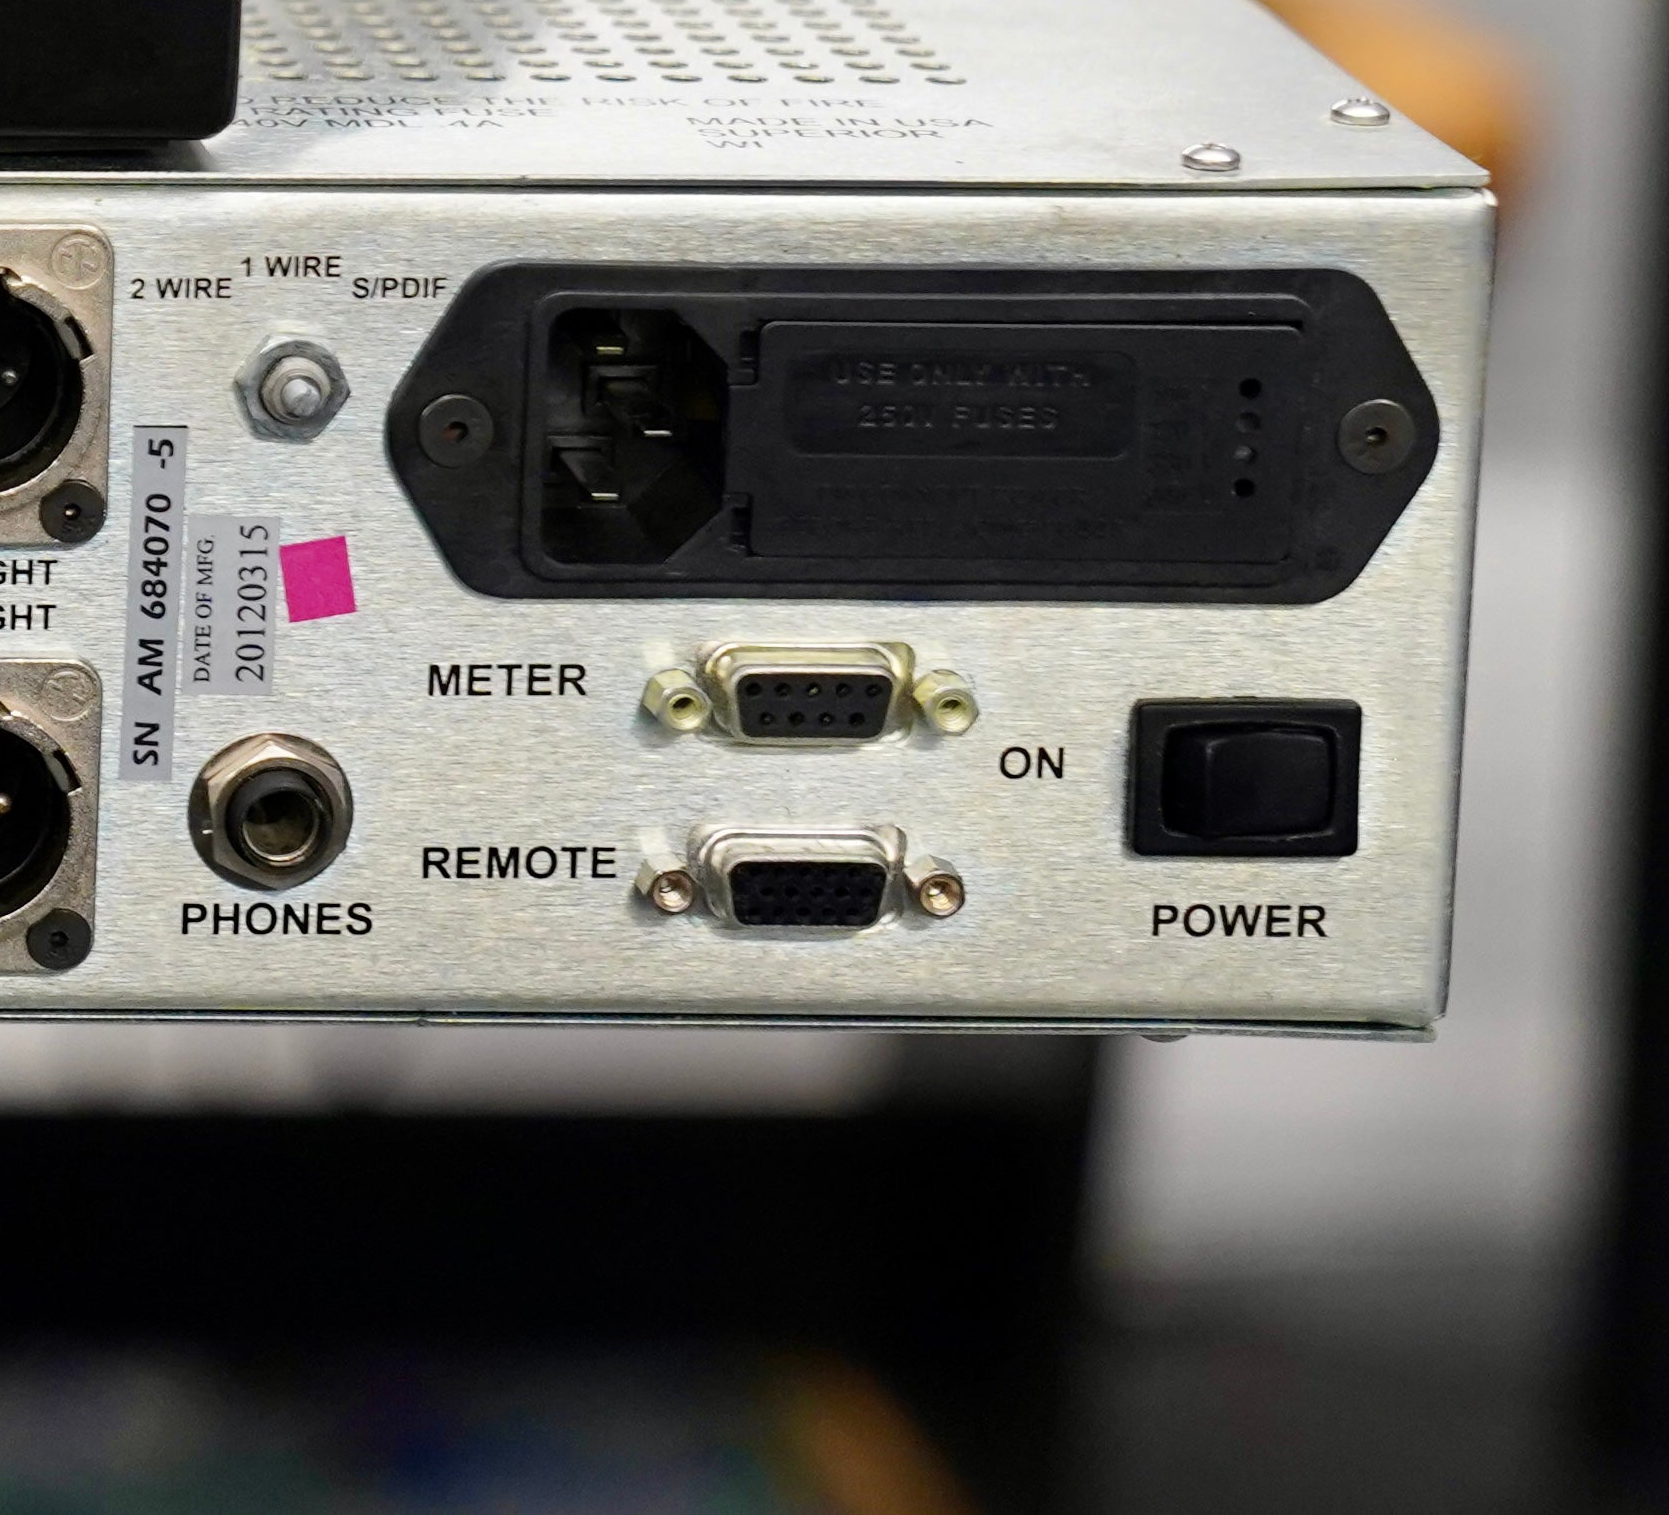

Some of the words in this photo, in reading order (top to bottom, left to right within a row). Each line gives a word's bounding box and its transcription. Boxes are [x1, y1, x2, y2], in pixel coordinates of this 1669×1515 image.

[249, 107, 420, 117] RATING
[434, 108, 556, 117] FUSE
[270, 95, 463, 106] REDUCE
[484, 96, 557, 106] THE
[580, 97, 689, 106] RISK
[703, 98, 762, 107] OF
[781, 98, 884, 108] FIRE
[323, 118, 422, 128] MDL
[685, 117, 823, 127] MADE
[834, 117, 883, 127] IN
[893, 118, 996, 128] USA
[696, 128, 948, 139] SUPERIOR
[704, 140, 765, 149] WI
[242, 257, 251, 277] 1
[265, 255, 341, 278] WIRE
[131, 278, 145, 300] 2
[156, 277, 232, 299] WIRE
[352, 277, 447, 299] S/PDIF
[147, 437, 175, 469] -5
[140, 492, 173, 621] 684070
[194, 590, 213, 620] OF
[234, 524, 270, 683] 20120315
[137, 637, 165, 697] AM
[192, 624, 211, 683] DATE
[428, 663, 586, 697] METER
[133, 720, 160, 767] SN
[999, 746, 1064, 780] ON
[422, 845, 617, 880] REMOTE
[181, 902, 373, 936] PHONES
[1152, 903, 1327, 938] POWER
